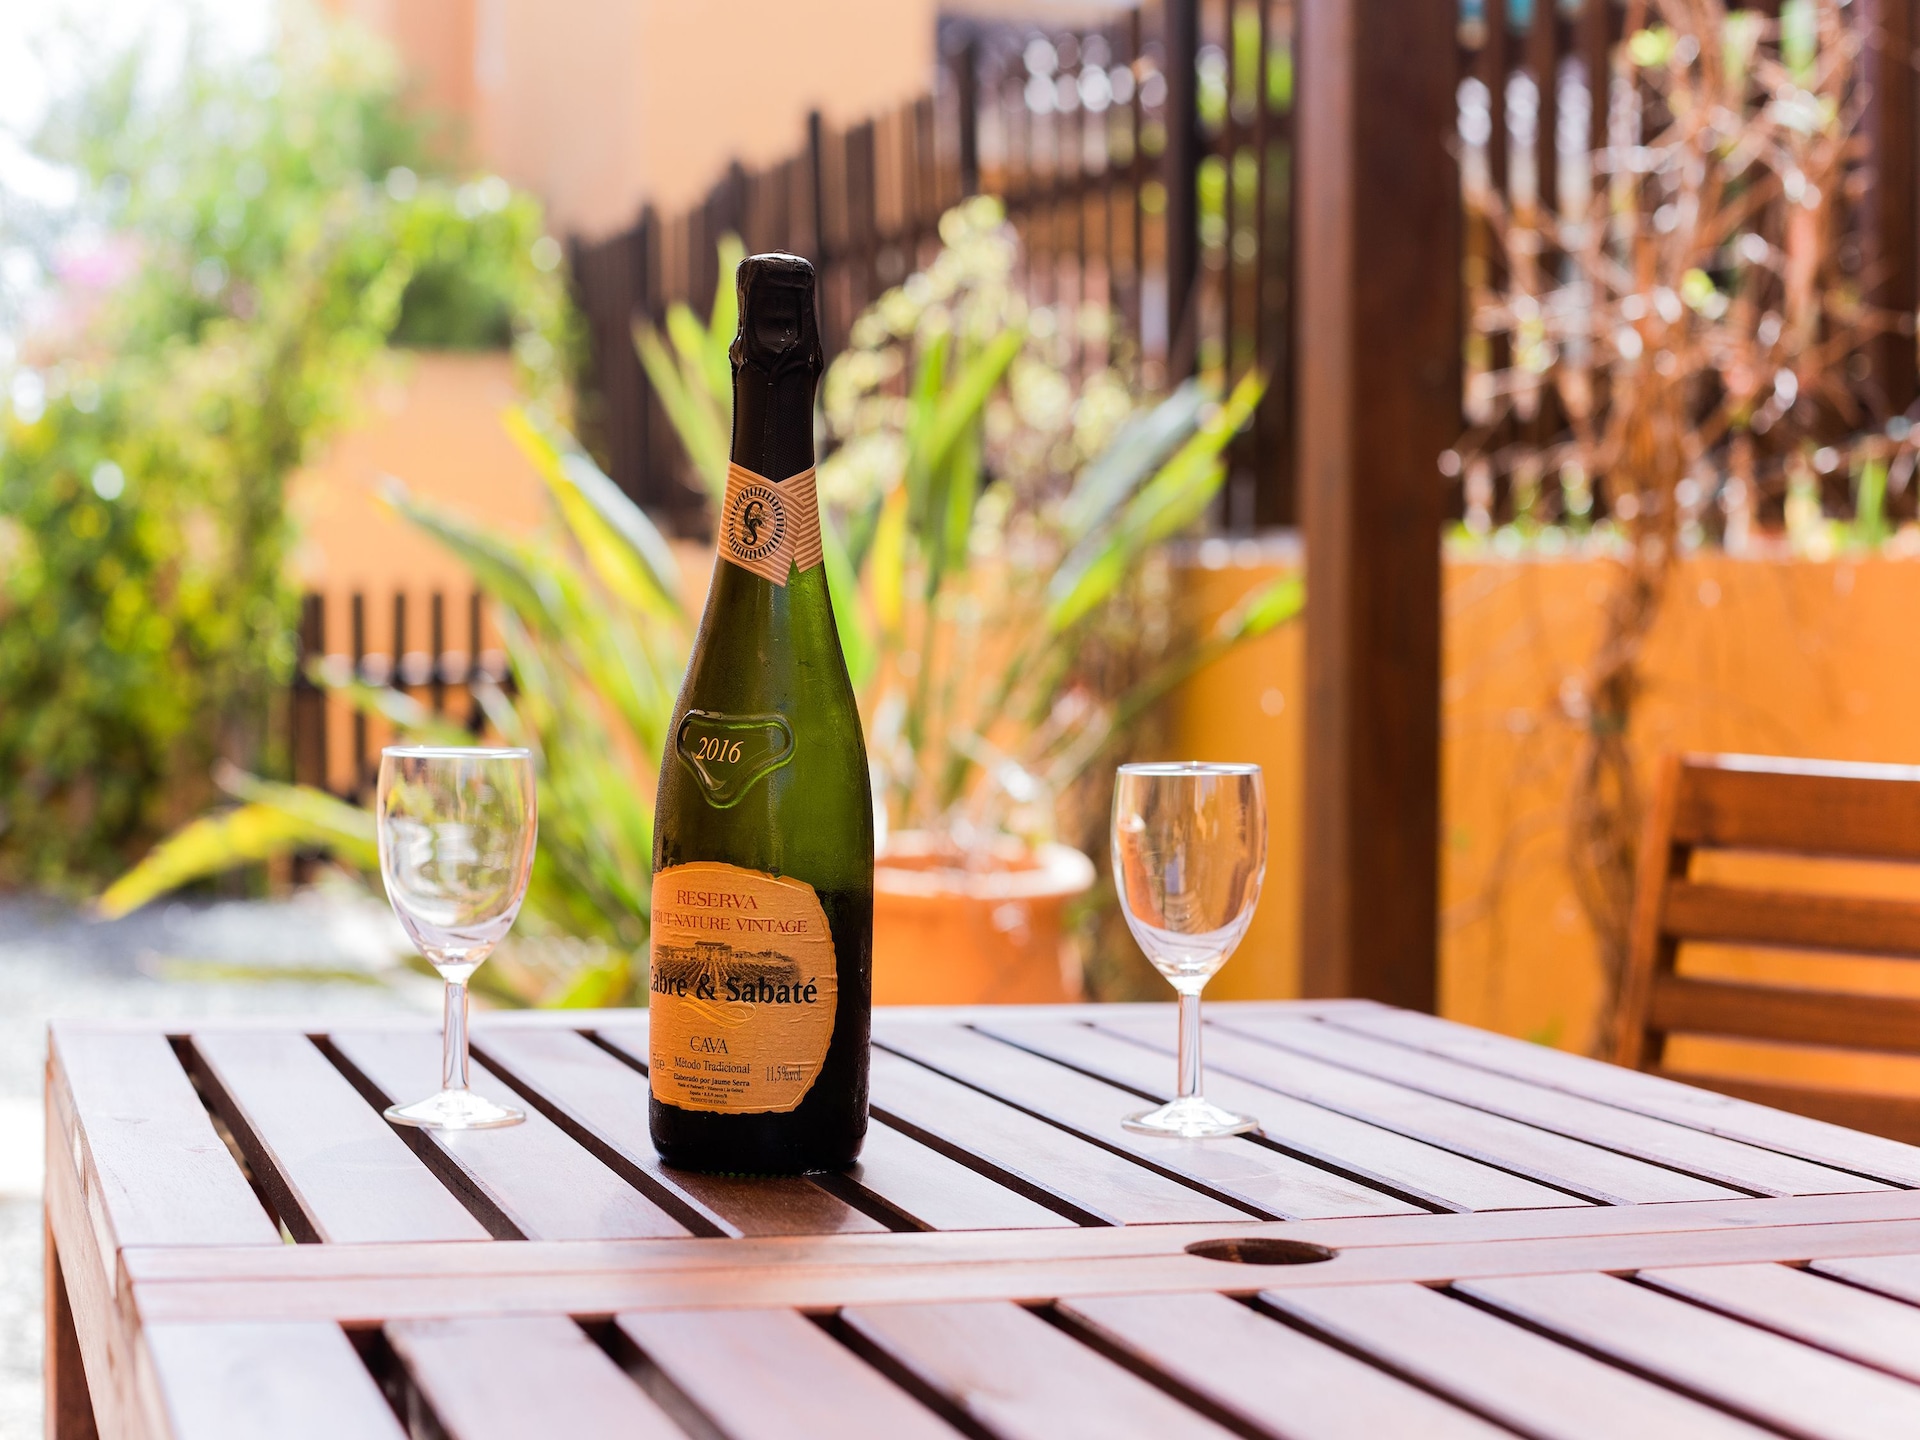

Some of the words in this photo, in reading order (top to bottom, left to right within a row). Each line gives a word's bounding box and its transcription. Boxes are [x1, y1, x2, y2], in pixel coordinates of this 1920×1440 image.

[695, 736, 745, 764] 2016
[677, 889, 758, 910] RESERVA
[652, 909, 672, 925] BRUT
[674, 913, 731, 931] NATURE
[736, 917, 808, 933] VINTAGE
[650, 965, 688, 998] Cabré
[696, 973, 718, 1001] &
[725, 976, 818, 1005] Sabaté
[690, 1035, 729, 1054] CAVA
[674, 1056, 701, 1070] Método
[703, 1060, 750, 1074] Tradicional
[673, 1072, 699, 1082] Elaborado
[711, 1077, 731, 1086] Jaume
[732, 1079, 750, 1087] Serra
